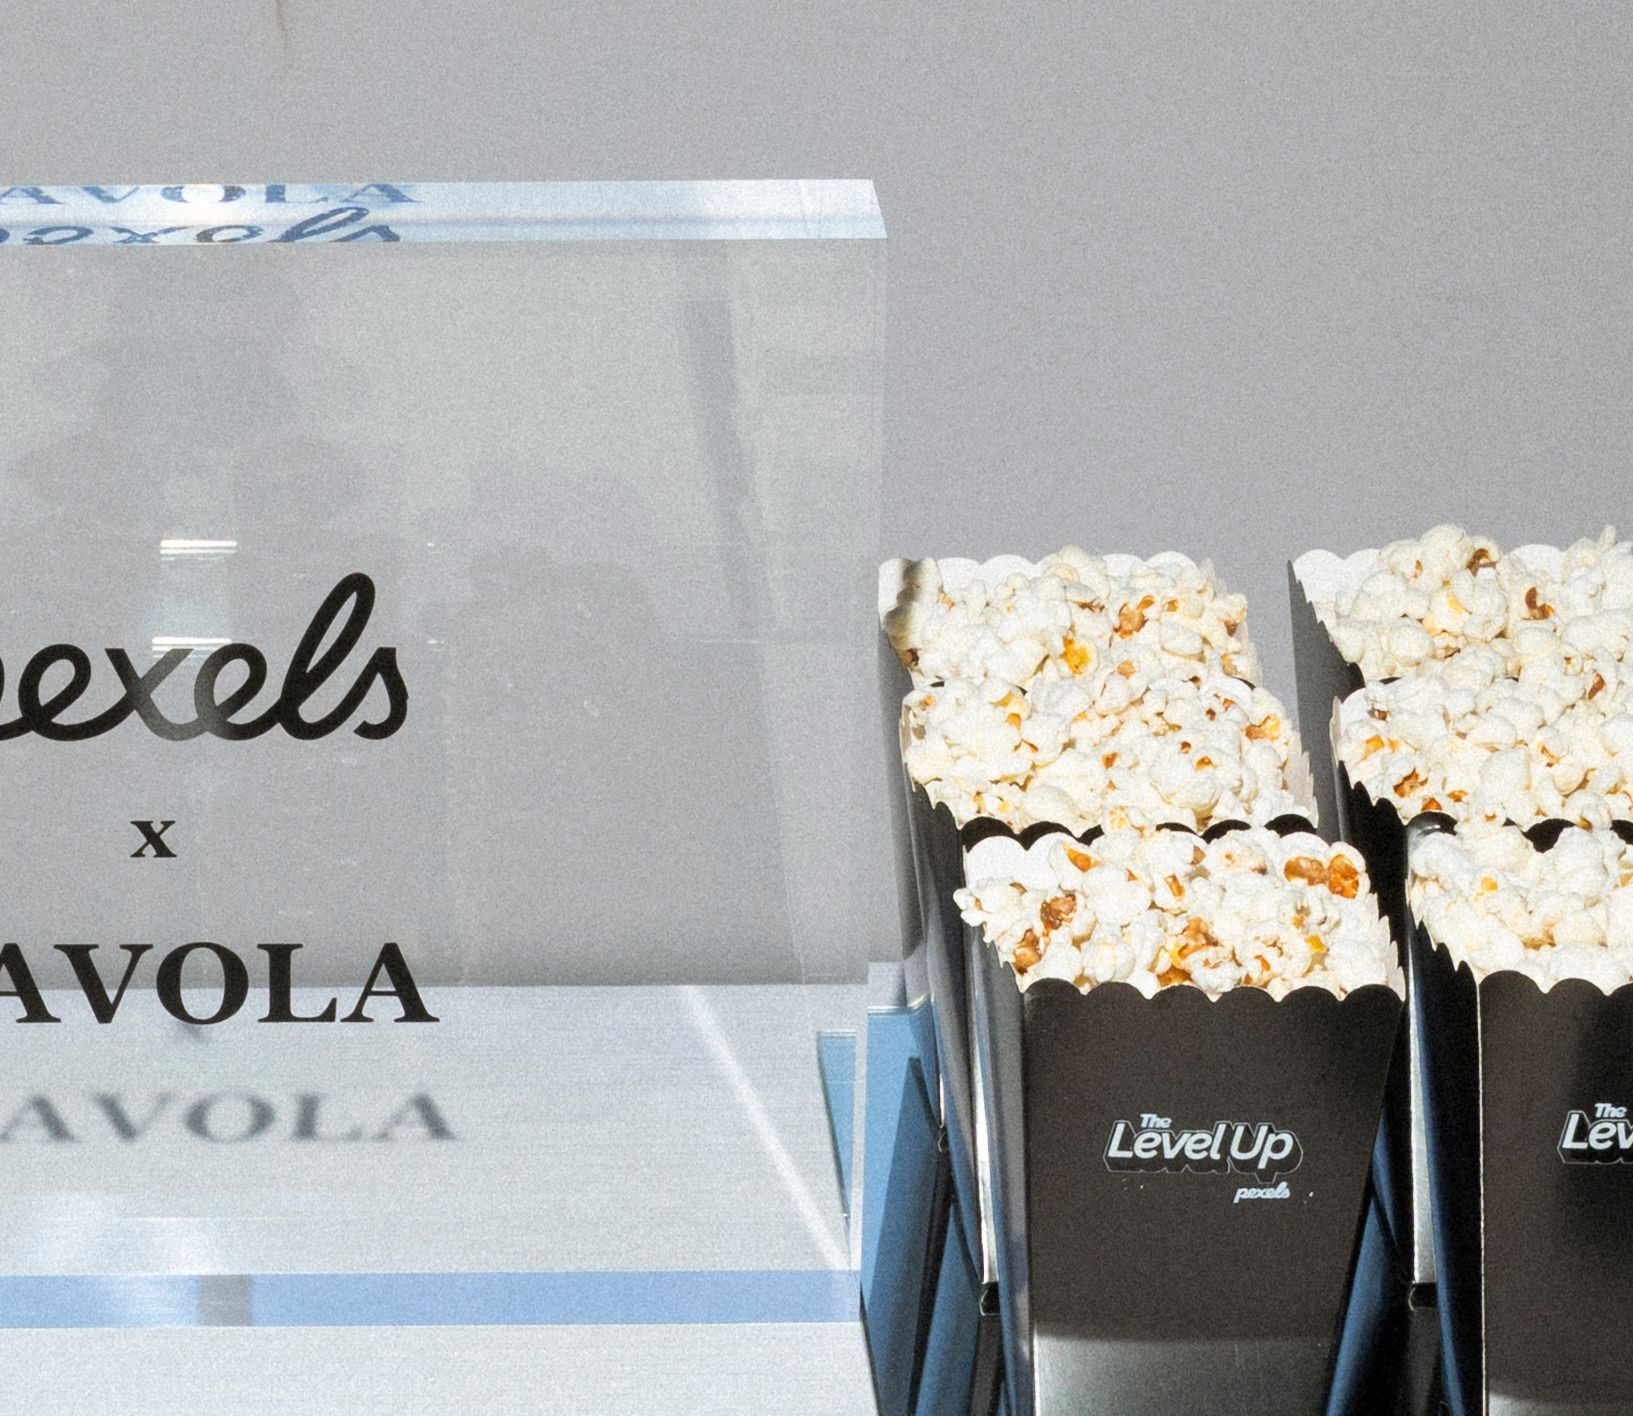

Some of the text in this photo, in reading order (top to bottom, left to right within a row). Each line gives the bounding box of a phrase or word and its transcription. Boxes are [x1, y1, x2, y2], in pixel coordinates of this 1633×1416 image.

[129, 820, 178, 858] x
[1139, 1113, 1173, 1129] The
[1595, 1102, 1628, 1119] The
[1107, 1122, 1296, 1172] Level Up
[1232, 1180, 1291, 1204] pexels
